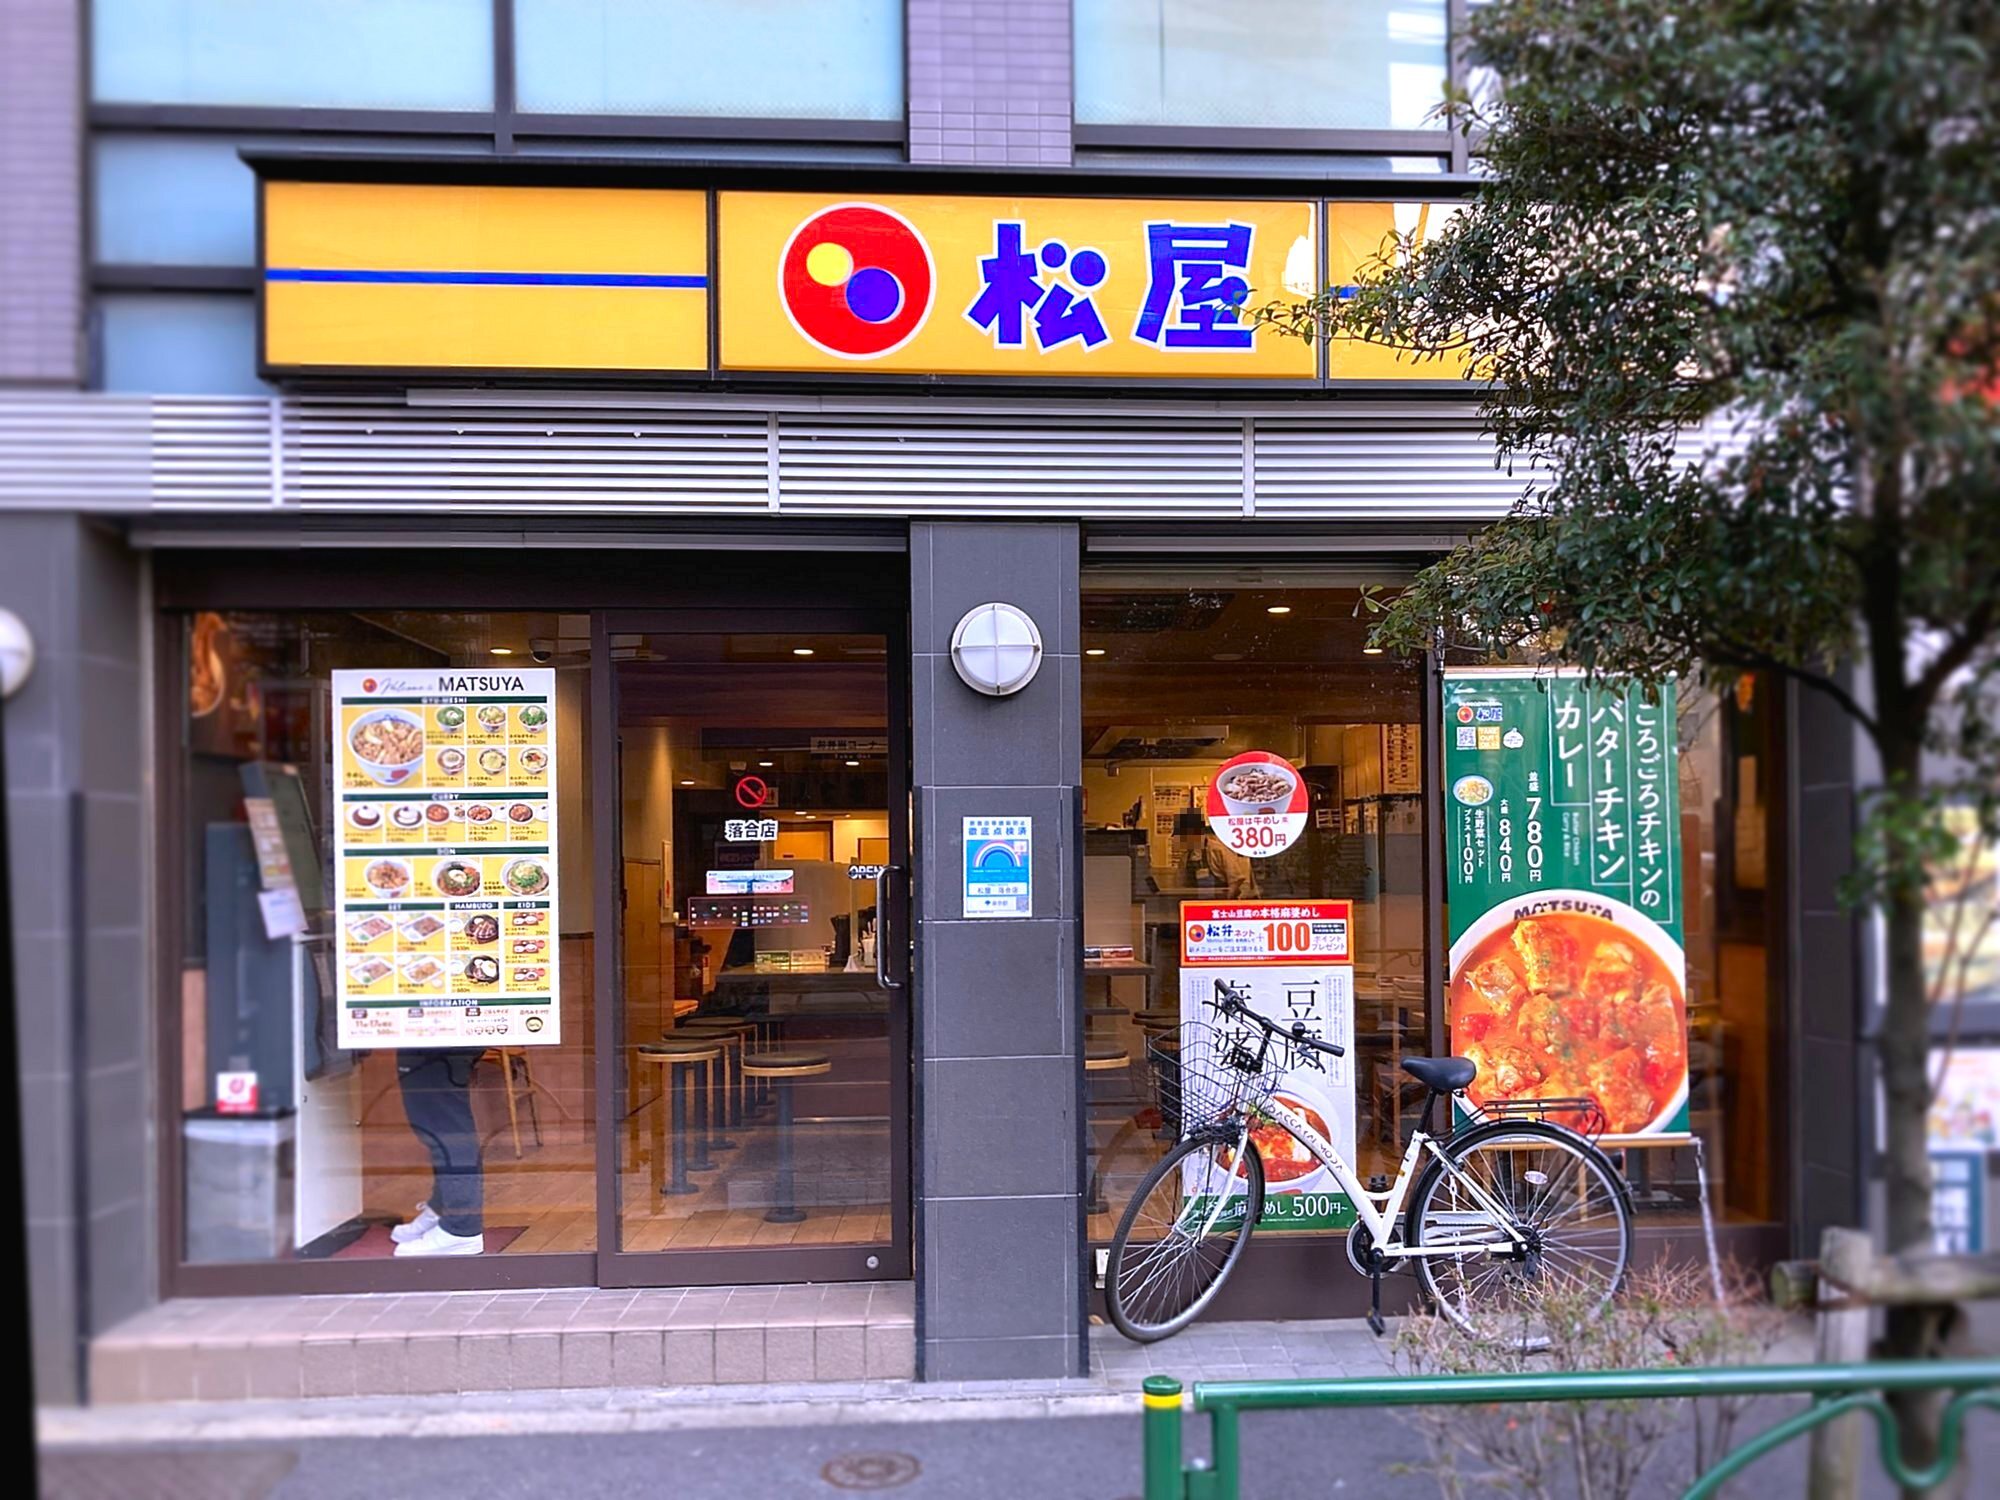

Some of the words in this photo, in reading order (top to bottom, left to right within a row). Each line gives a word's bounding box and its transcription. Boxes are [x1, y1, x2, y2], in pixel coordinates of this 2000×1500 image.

[963, 219, 1256, 353] 松屋
[438, 676, 524, 692] MATSUYA
[1554, 699, 1584, 788] カレー
[1591, 699, 1626, 880] バターチキン
[725, 819, 778, 841] 落合店
[1228, 815, 1280, 826] 松屋は牛めし
[1231, 826, 1287, 849] 380円
[1474, 808, 1485, 868] 生野菜セット
[1526, 797, 1543, 883] 780円
[1499, 818, 1513, 883] 840円
[1512, 900, 1614, 921] MATSUYA
[1312, 943, 1345, 951] プレゼント
[1313, 935, 1343, 943] ポイント
[419, 999, 478, 1007] INFORMATION
